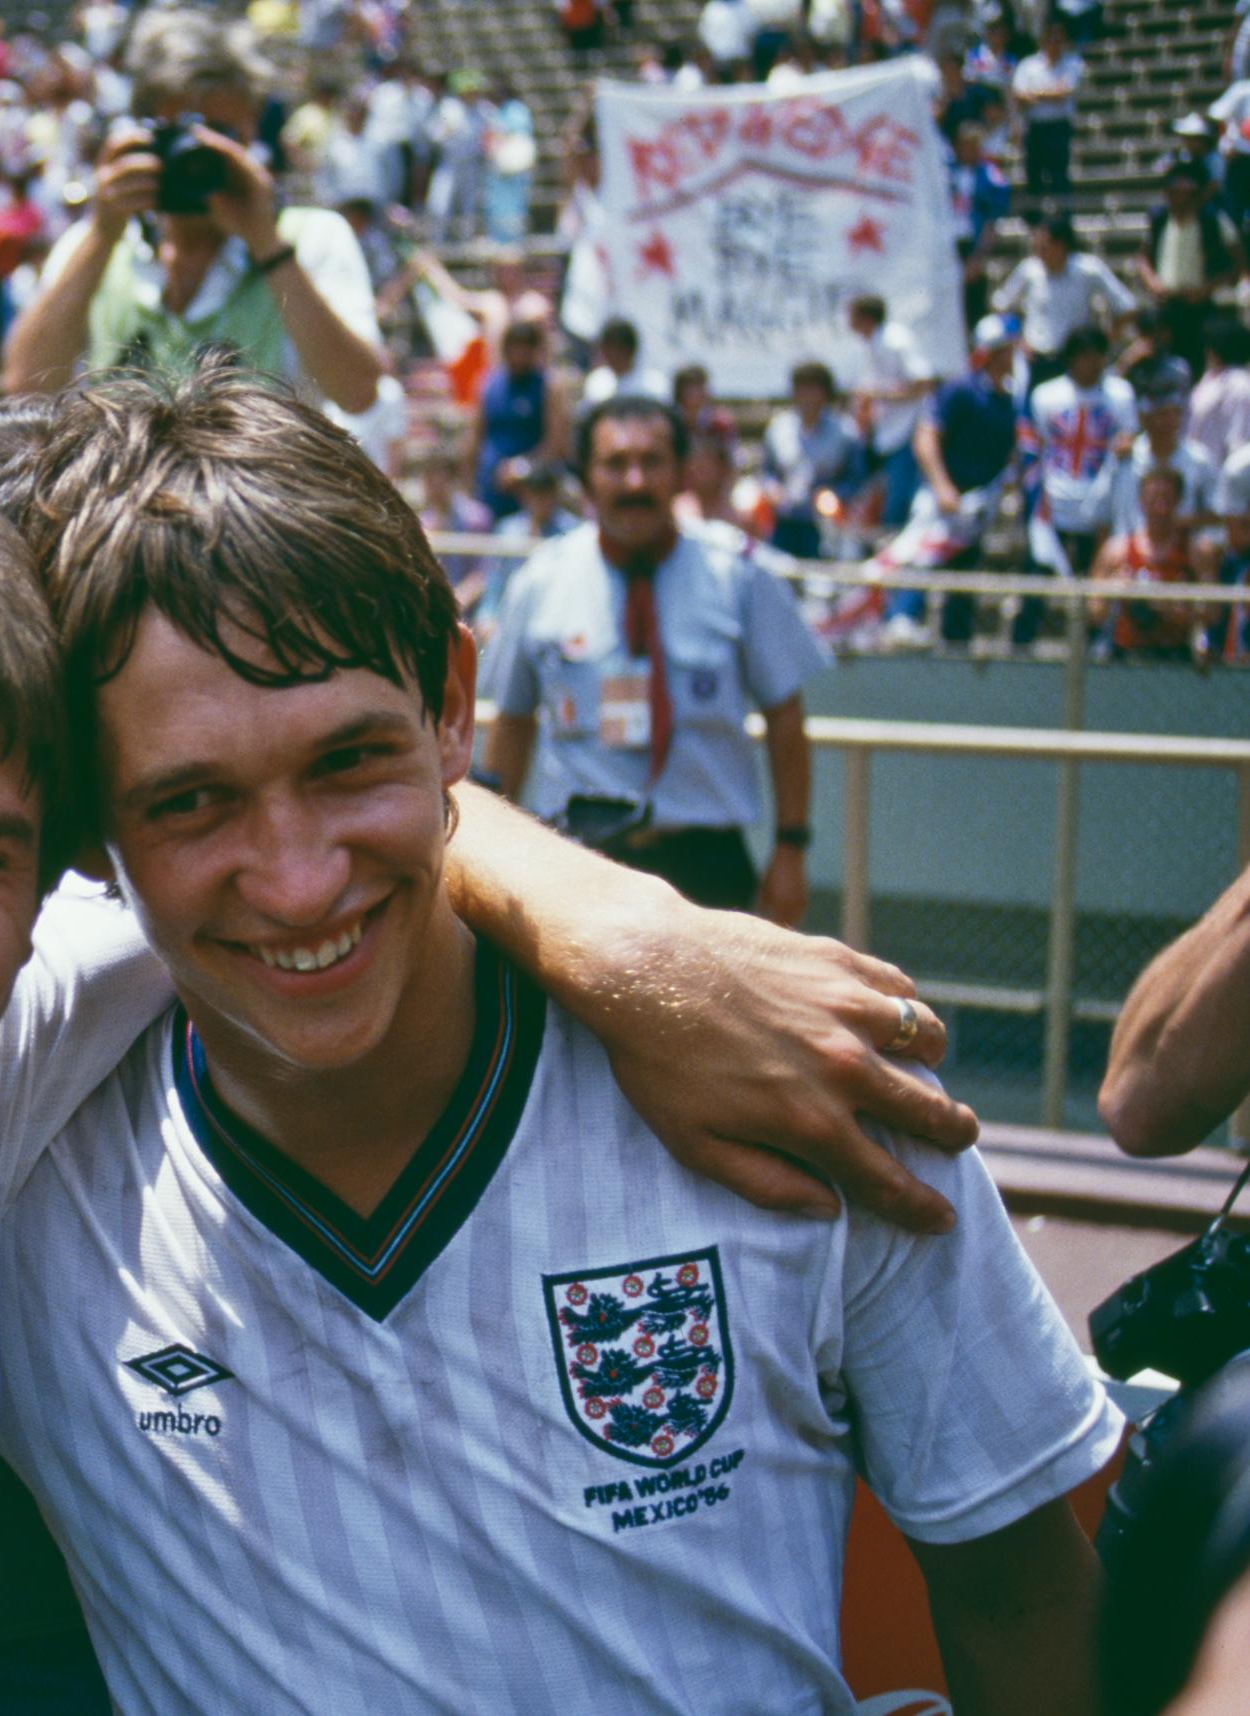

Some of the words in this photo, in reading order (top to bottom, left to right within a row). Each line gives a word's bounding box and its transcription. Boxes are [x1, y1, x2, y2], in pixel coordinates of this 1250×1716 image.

[138, 1402, 222, 1437] umbro
[583, 1481, 634, 1509] FIFA
[634, 1463, 708, 1499] WORLD
[709, 1448, 745, 1479] CUP
